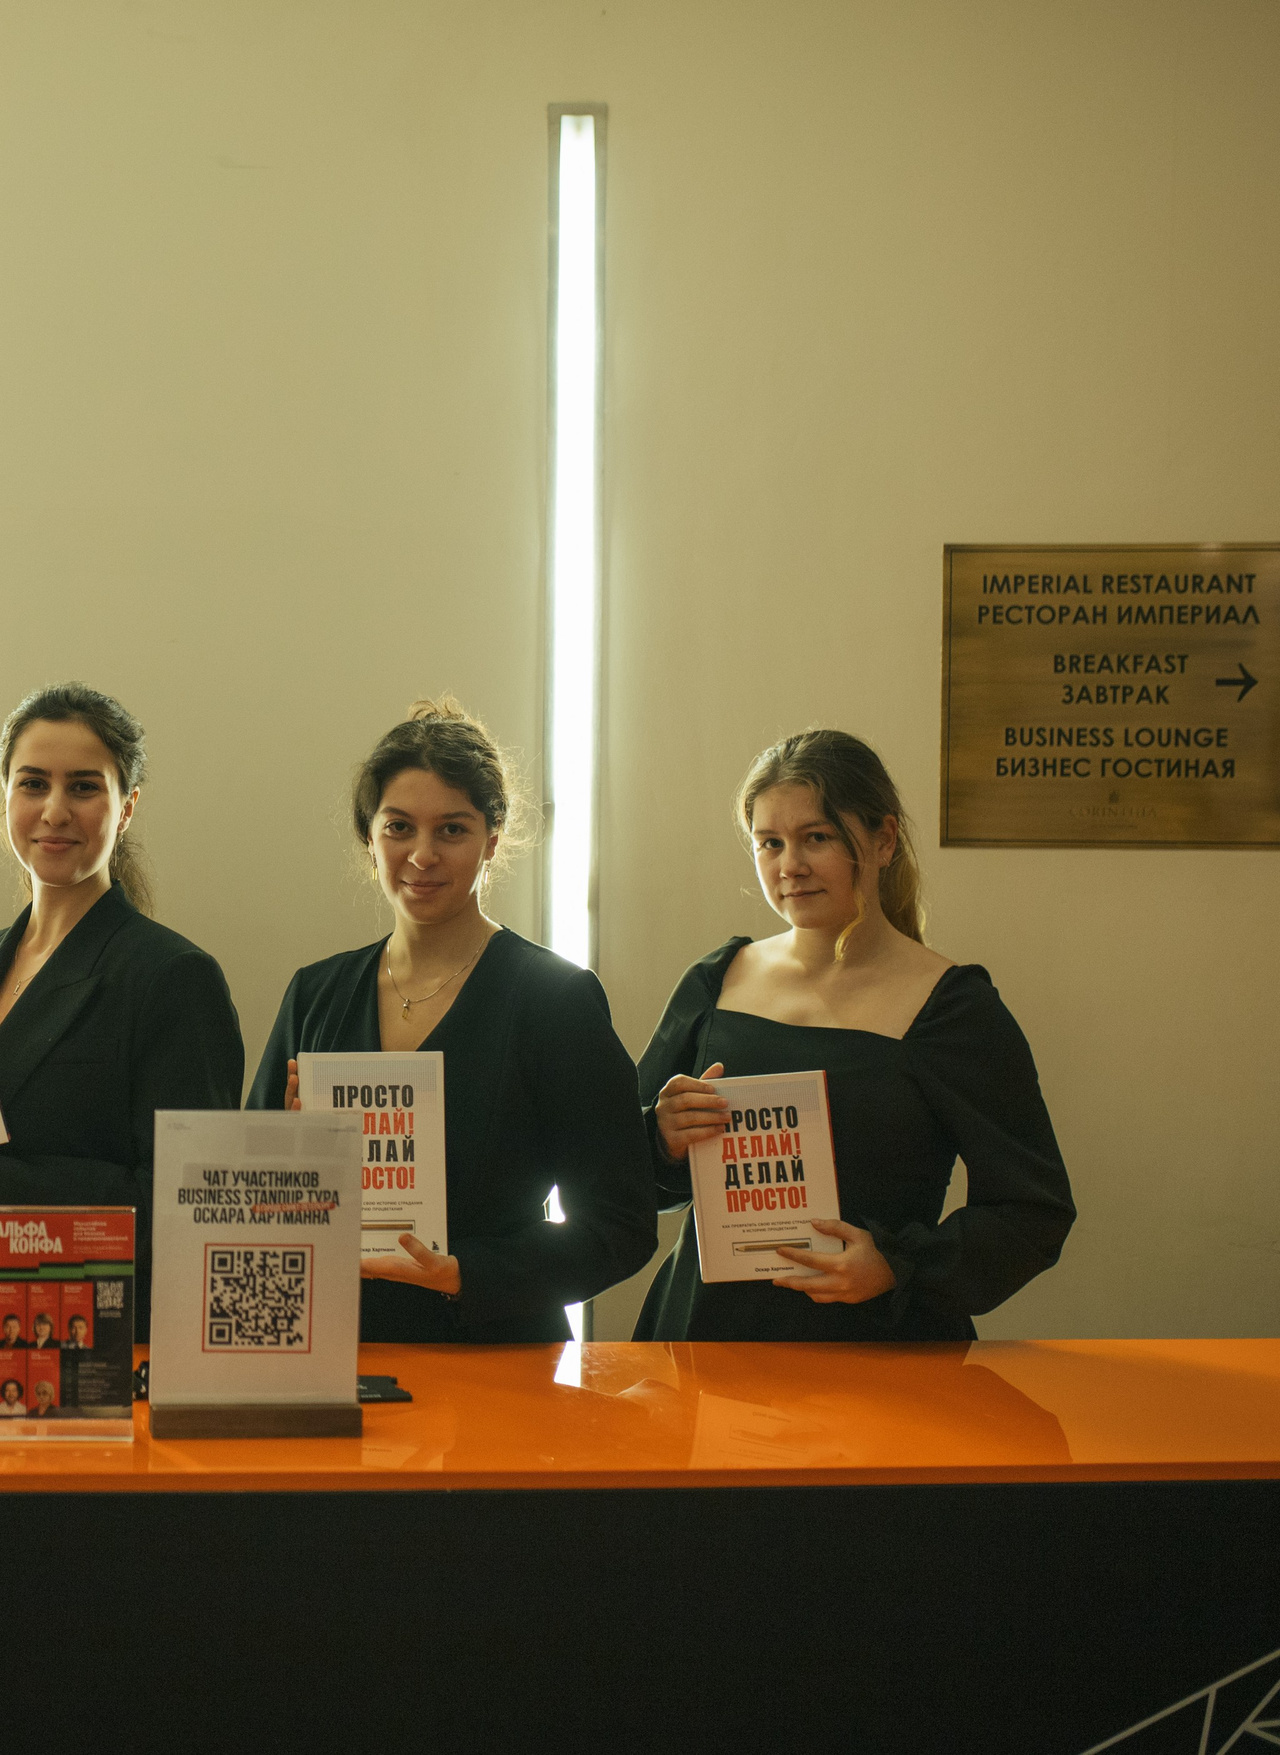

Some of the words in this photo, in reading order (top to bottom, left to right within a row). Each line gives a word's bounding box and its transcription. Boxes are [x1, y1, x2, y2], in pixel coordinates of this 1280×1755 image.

[982, 573, 1093, 595] IMPERIAL
[1101, 573, 1257, 595] RESTAURANT
[977, 604, 1108, 626] РЕСТОРАН
[1117, 604, 1260, 626] ИМПЕРИАЛ
[1053, 654, 1189, 675] BREAKFAST
[1061, 684, 1170, 705] ЗАВТРАК
[1004, 727, 1114, 748] BUSINESS
[1123, 727, 1229, 748] LOUNGE
[995, 757, 1091, 779] БИЗНЕС
[1100, 758, 1236, 779] ГОСТИНАЯ
[332, 1085, 414, 1108] ПРОСТО
[362, 1107, 414, 1135] ЛАЙ!
[366, 1135, 415, 1162] ЛАЙ
[721, 1129, 802, 1163] ДЕЛАЙ!
[203, 1170, 229, 1187] ЧАТ
[232, 1170, 320, 1188] УЧАСТНИКОВ
[361, 1167, 415, 1190] ОСТО!
[725, 1155, 805, 1190] ДЕЛАЙ
[178, 1188, 241, 1206] BUSINESS
[244, 1189, 304, 1207] STANDUP
[726, 1186, 808, 1213] ПРОСТО!
[193, 1207, 246, 1225] ОСКАРА
[9, 1236, 63, 1255] КОНФА
